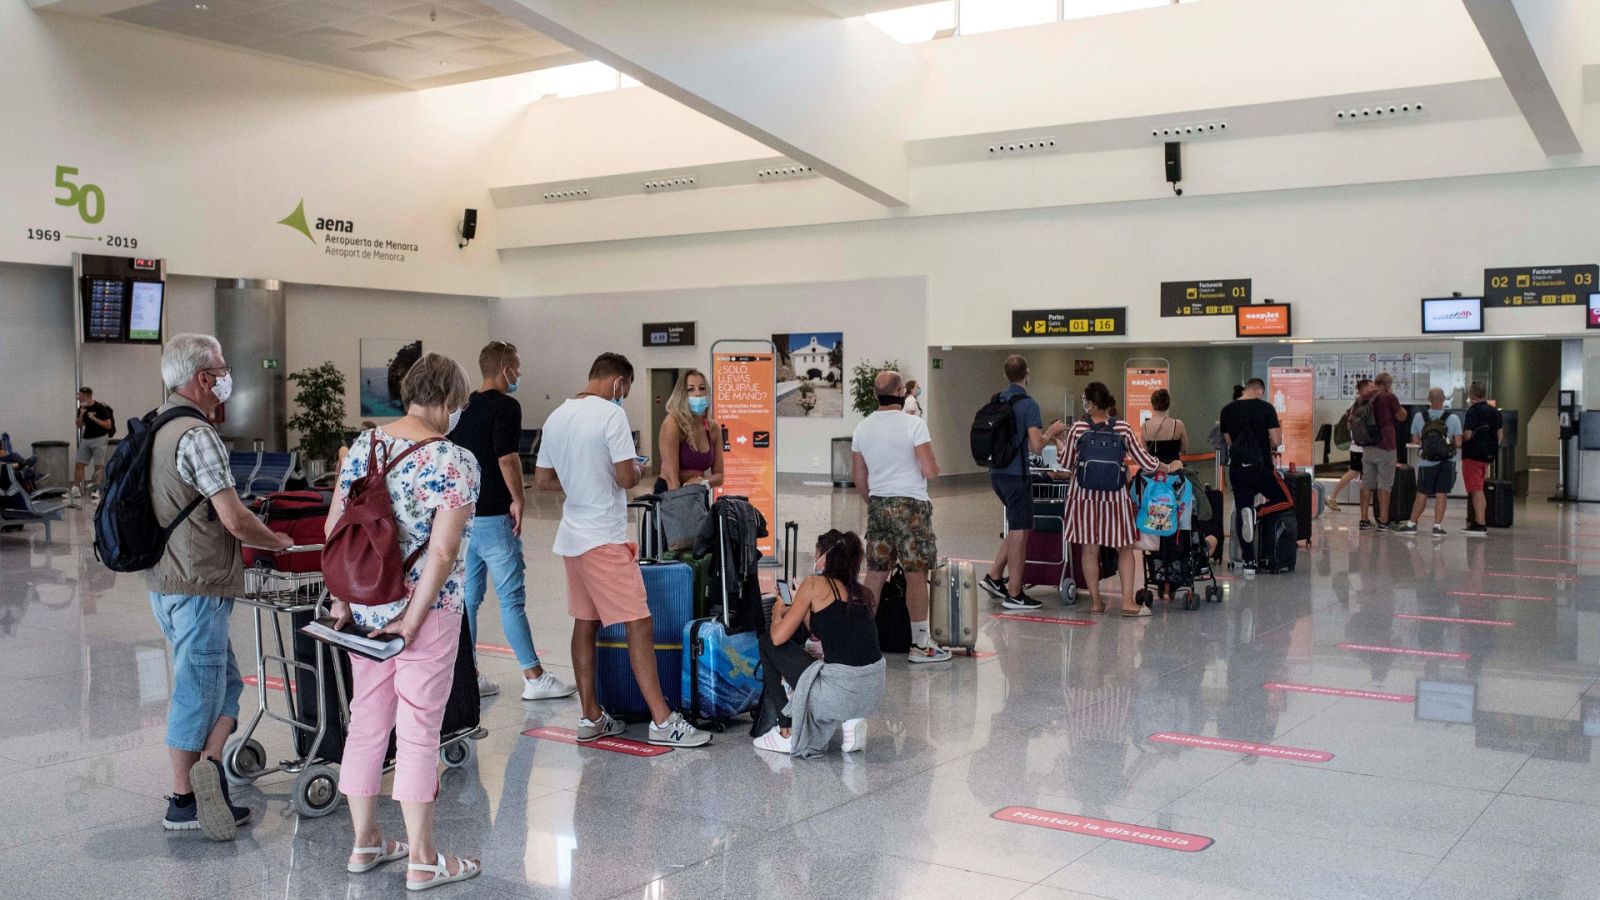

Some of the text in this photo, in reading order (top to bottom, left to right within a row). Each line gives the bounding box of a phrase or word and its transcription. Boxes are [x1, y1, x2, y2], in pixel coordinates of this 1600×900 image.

[55, 165, 105, 224] 50
[315, 217, 354, 233] aena
[28, 228, 138, 249] 1969 2019
[325, 234, 419, 252] Aeropuerto de Menorca
[325, 246, 405, 262] Aeroport de Menorca
[1492, 276, 1508, 288] 02
[1574, 273, 1592, 285] 03
[1232, 286, 1246, 297] 01
[1246, 312, 1280, 320] easyJet
[1073, 321, 1085, 330] 01
[1099, 320, 1111, 330] 16
[718, 365, 749, 375] ¿SOLO
[718, 374, 751, 383] LLEVAS
[1131, 378, 1162, 387] easyJet
[718, 383, 760, 392] EQUIPAJE
[718, 391, 768, 401] DE MANO?
[1083, 822, 1100, 831] la
[1104, 827, 1189, 846] distancia
